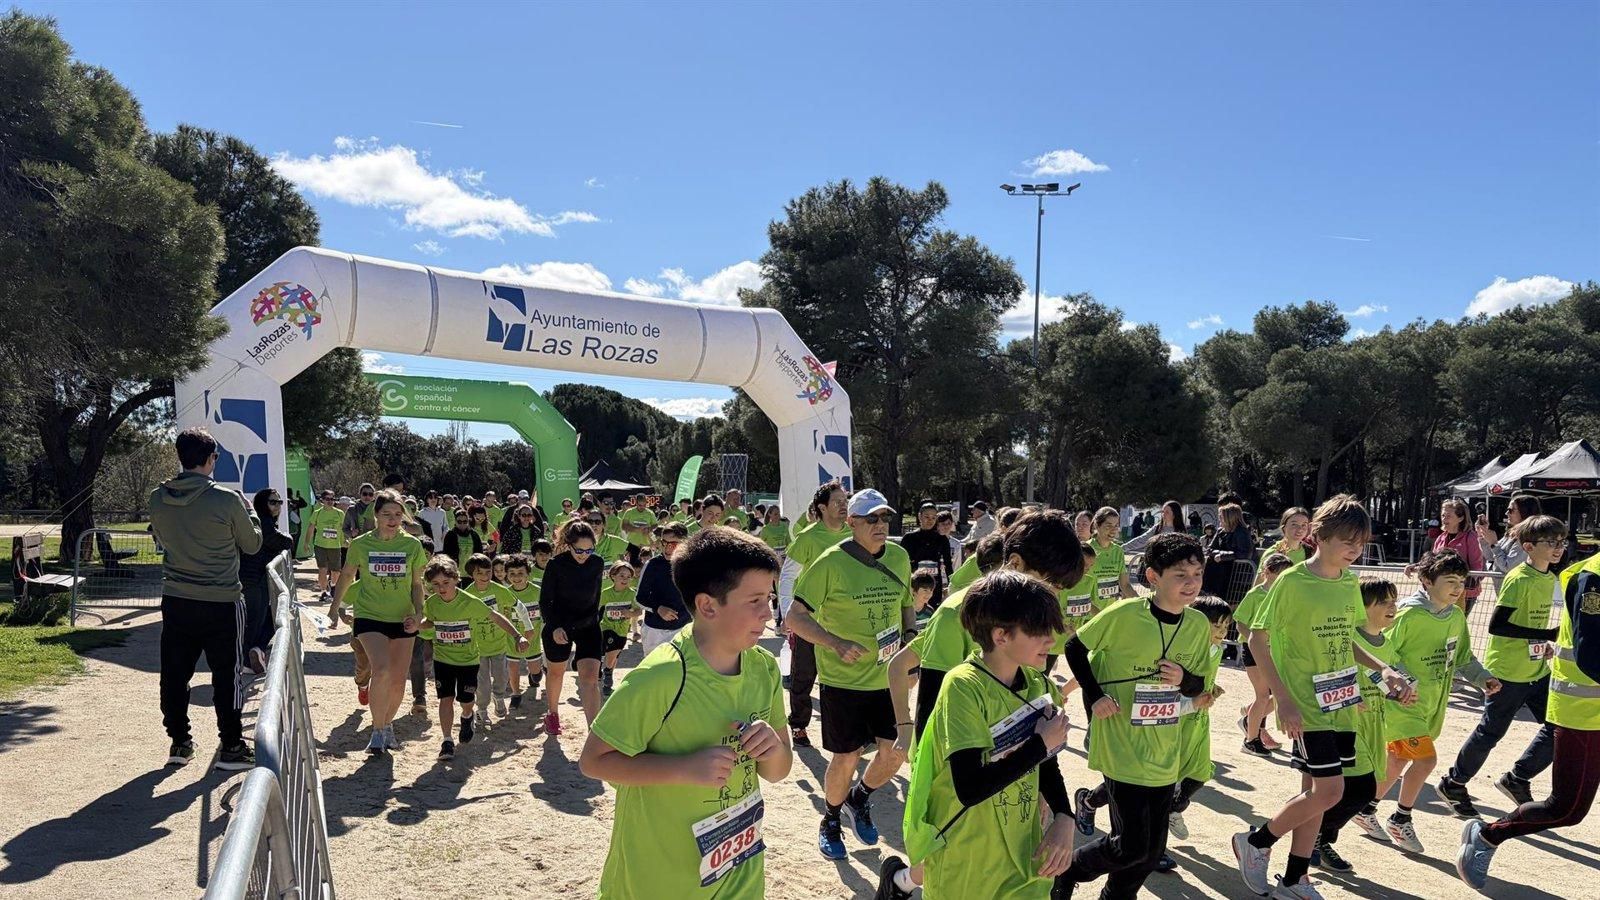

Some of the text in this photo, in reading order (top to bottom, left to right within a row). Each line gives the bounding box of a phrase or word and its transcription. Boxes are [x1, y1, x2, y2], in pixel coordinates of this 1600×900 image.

[530, 309, 661, 338] Ayuntamiento de
[246, 322, 291, 358] LasRozas
[525, 329, 659, 364] Las Rozas
[255, 331, 298, 366] Deportes
[775, 356, 804, 388] Deportes
[413, 384, 458, 393] asociación
[414, 393, 453, 402] española
[413, 404, 441, 412] contra
[443, 404, 451, 412] el
[374, 564, 401, 572] 0069
[1101, 586, 1117, 595] 0117
[440, 631, 465, 639] 0068
[1322, 685, 1355, 704] 0239
[1139, 703, 1176, 717] 0243
[710, 826, 755, 869] 0238
